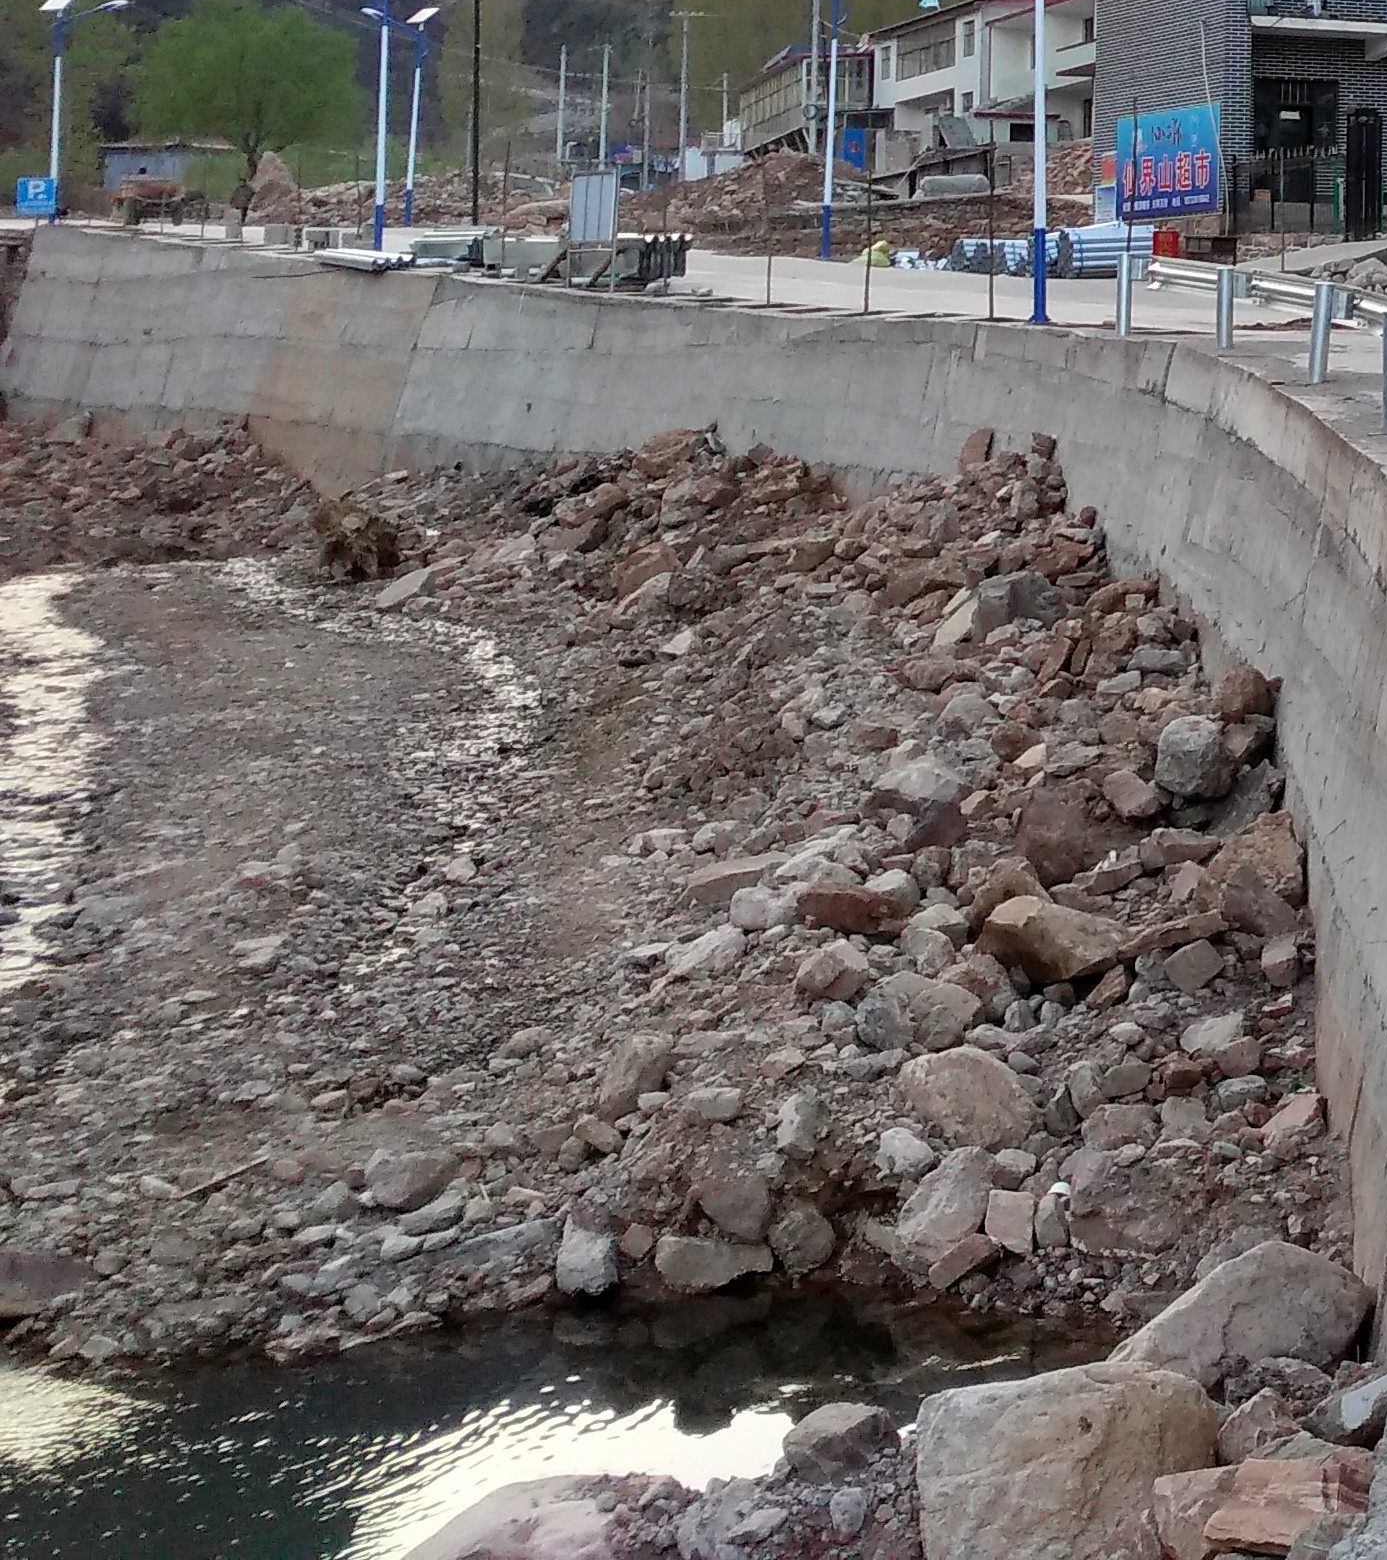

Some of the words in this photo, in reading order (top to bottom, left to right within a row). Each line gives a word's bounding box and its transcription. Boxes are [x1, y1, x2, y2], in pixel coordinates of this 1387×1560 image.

[28, 180, 46, 199] P
[1123, 149, 1211, 198] 仙界山超市
